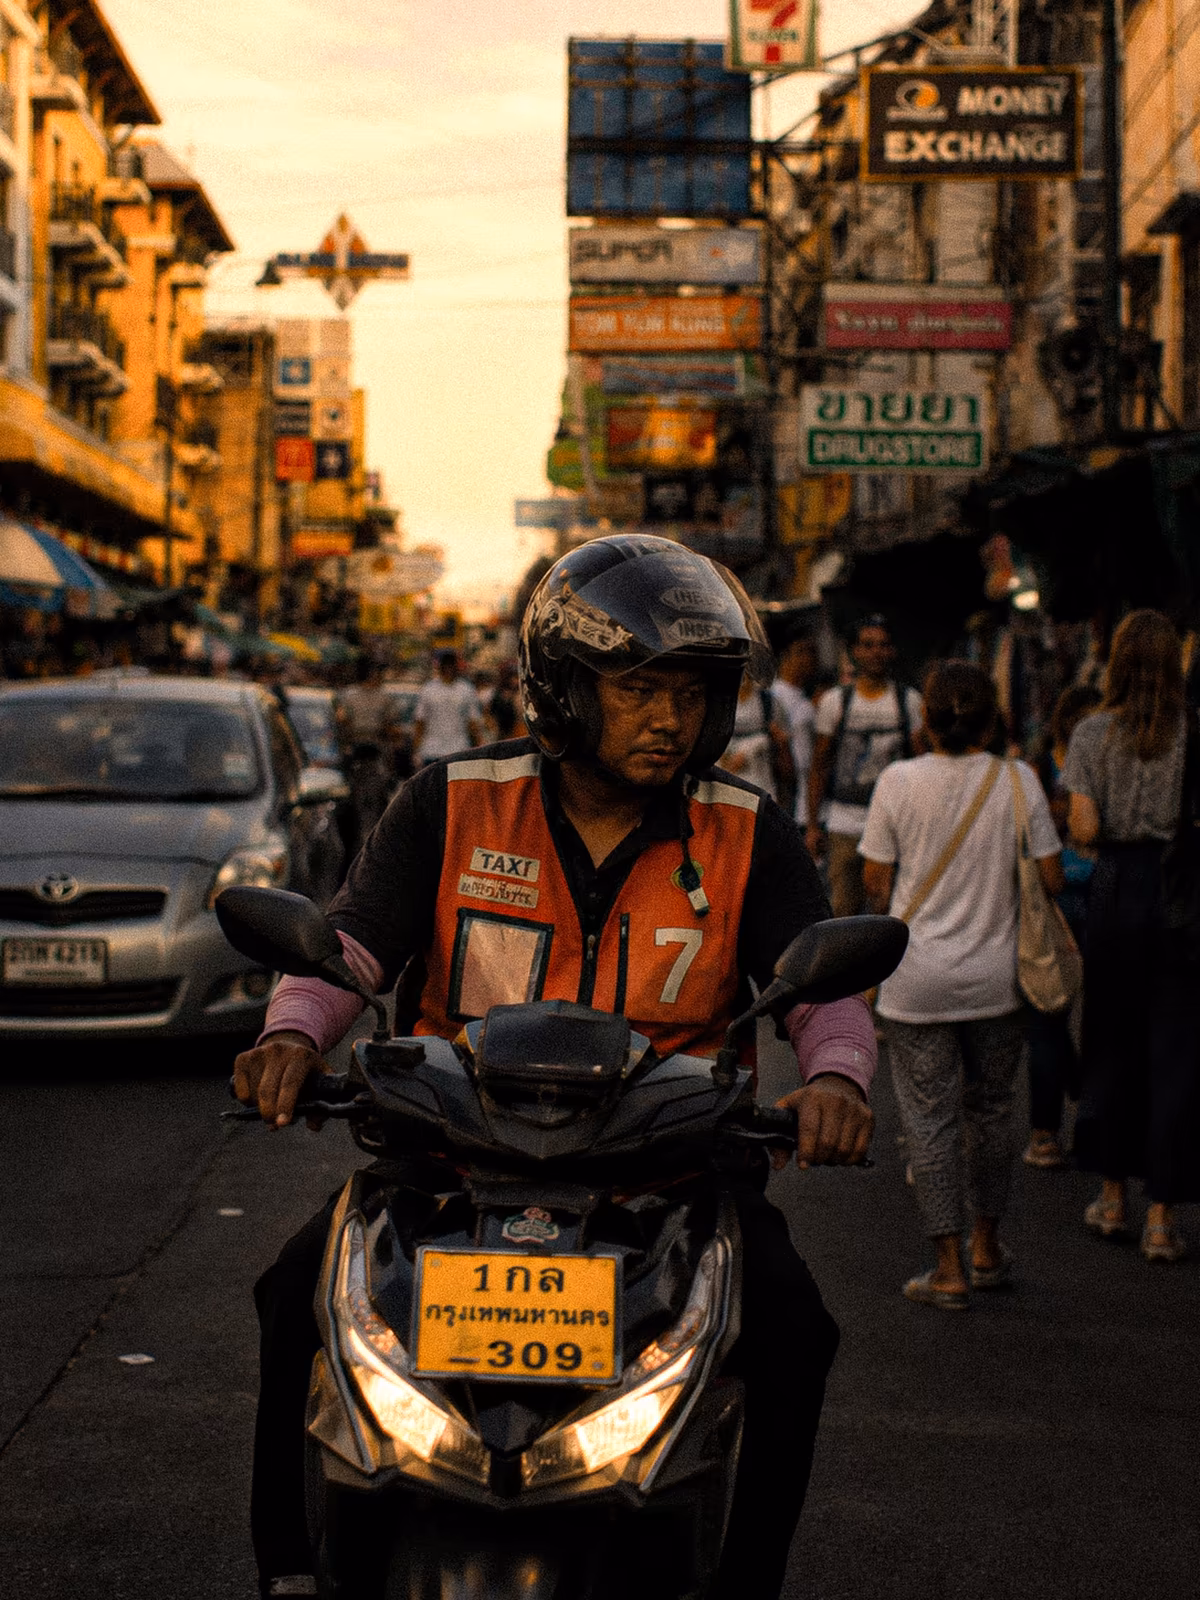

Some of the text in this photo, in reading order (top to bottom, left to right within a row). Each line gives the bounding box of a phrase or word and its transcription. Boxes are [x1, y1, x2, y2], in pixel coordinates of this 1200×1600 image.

[956, 84, 1065, 116] MONEY
[884, 131, 1066, 162] EXCHANGE
[813, 433, 977, 463] DRUGSTORE
[481, 853, 533, 877] TAXI
[655, 927, 704, 1004] 7
[487, 1341, 583, 1371] 309
